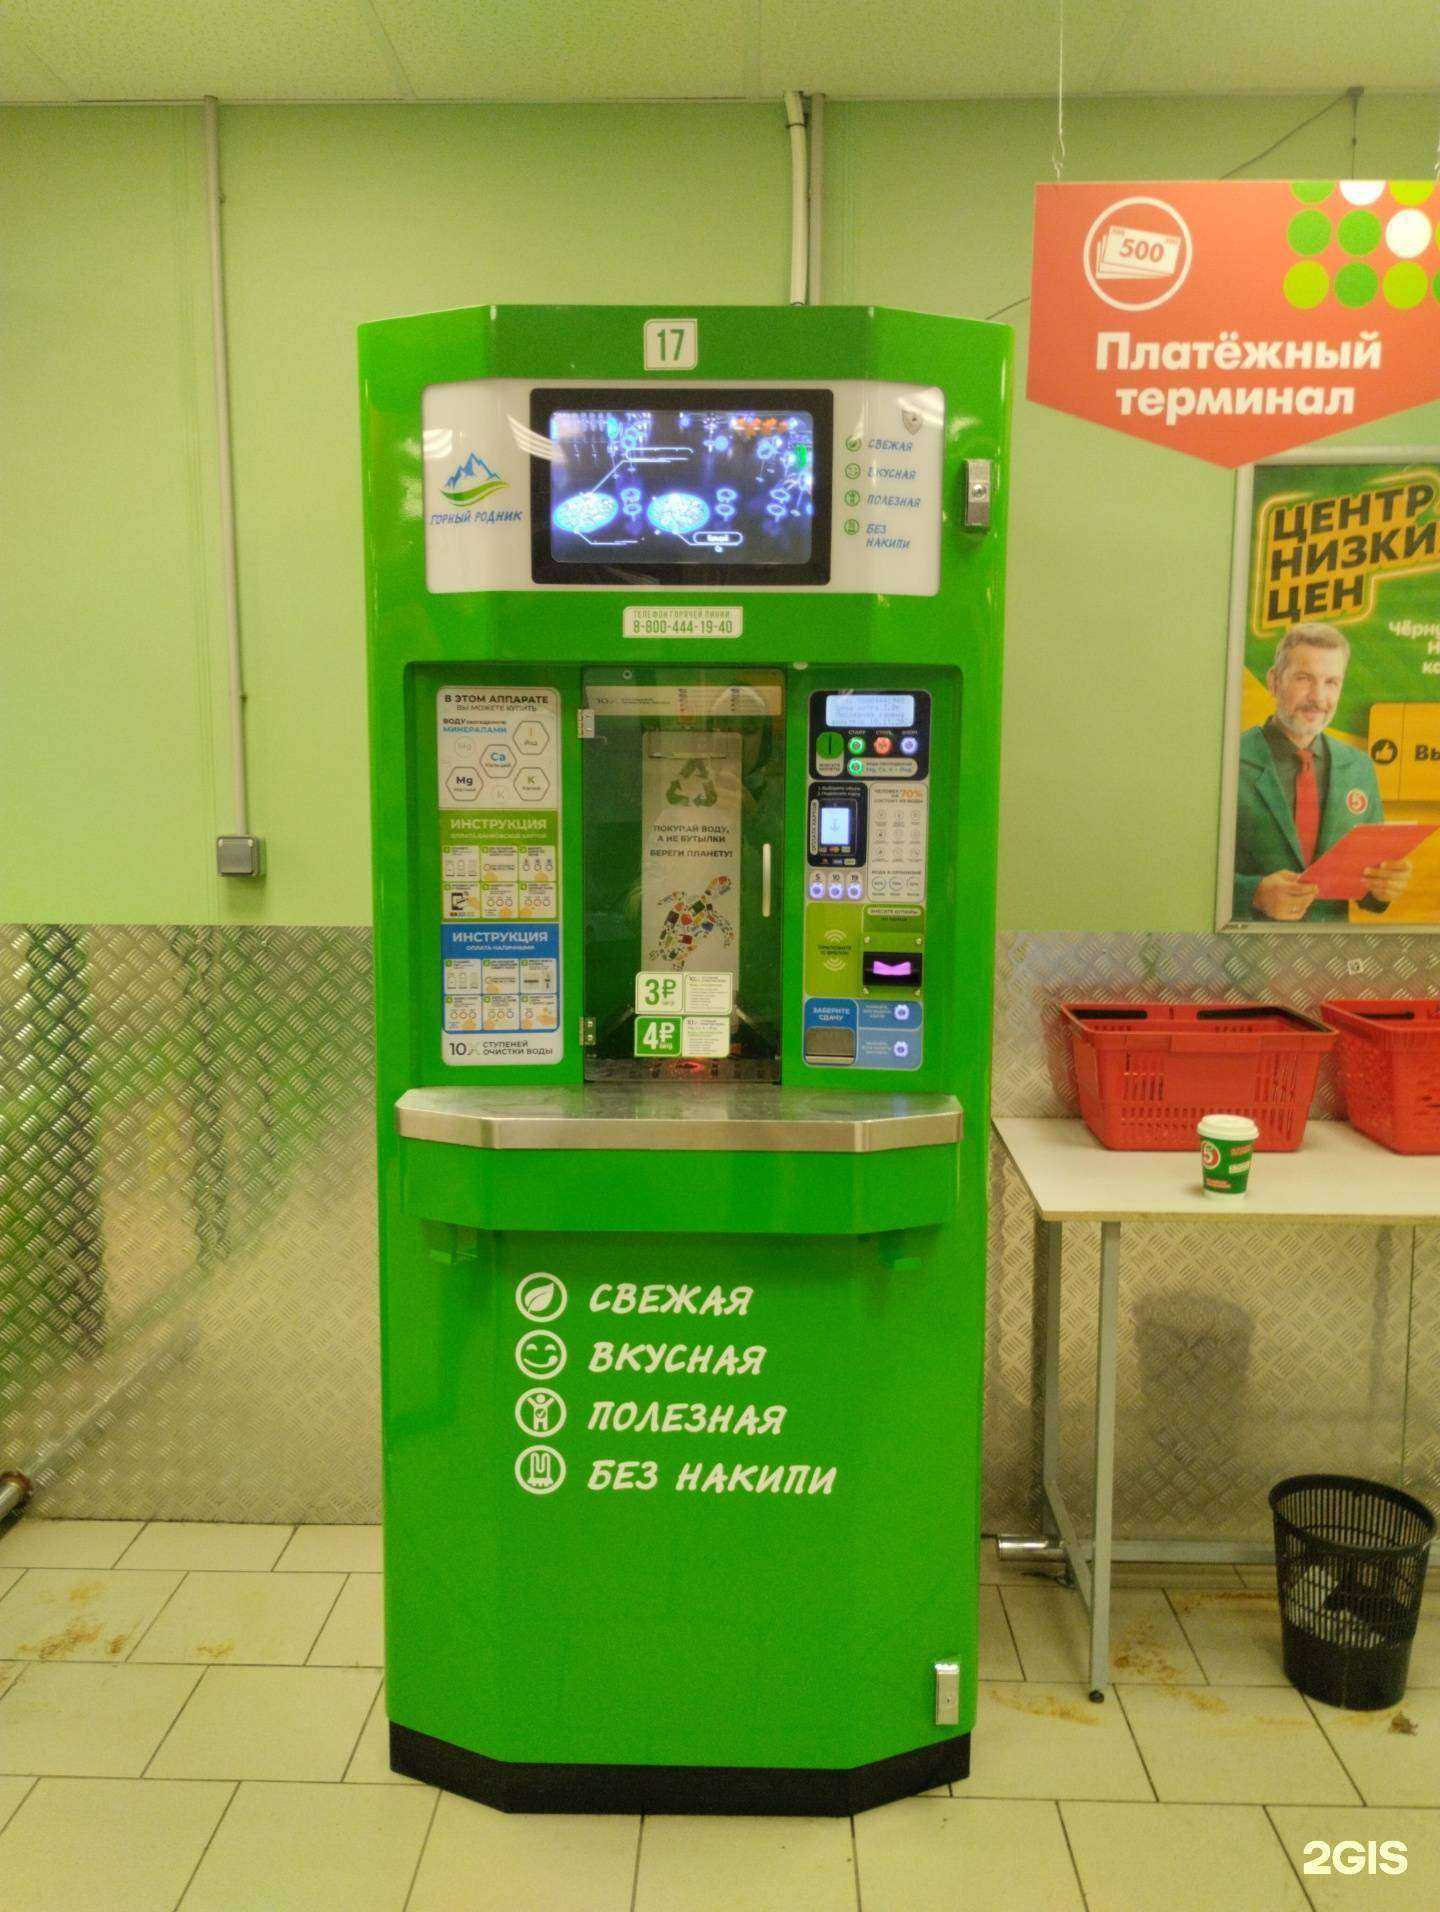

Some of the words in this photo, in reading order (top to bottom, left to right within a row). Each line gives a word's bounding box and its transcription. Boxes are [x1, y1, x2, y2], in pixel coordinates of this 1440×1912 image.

[1119, 238, 1164, 263] 500
[656, 328, 685, 362] 17
[1095, 330, 1383, 370] Платёжный
[1115, 386, 1356, 427] терминал
[868, 439, 913, 453] СВЕЖАЯ
[866, 494, 922, 508] ПОЛЕЗНАЯ
[430, 510, 472, 525] ГОРНЫЙ
[474, 510, 524, 525] РОДНИК
[1273, 484, 1435, 544] ЦЕНТР
[865, 523, 887, 535] БЕЗ
[865, 537, 911, 550] НАКИПИ
[1266, 574, 1364, 624] ЦЕН
[633, 619, 733, 634] 8-800-444-19-40
[444, 694, 452, 703] В
[454, 695, 486, 704] ЭТОМ
[488, 695, 549, 704] АППАРАТЕ
[490, 752, 506, 762] Ca
[456, 776, 473, 787] Mg
[450, 818, 548, 830] ИНСТРУКЦИЯ
[680, 835, 726, 844] БУТЫЛКИ
[452, 931, 549, 944] ИНСТРУКЦИЯ
[588, 1283, 754, 1316] СВЕЖАЯ
[588, 1341, 767, 1376] ВКУСНАЯ
[587, 1401, 788, 1436] ПОЛЕЗНАЯ
[587, 1459, 659, 1491] БЕЗ
[675, 1462, 838, 1495] НАКИПИ
